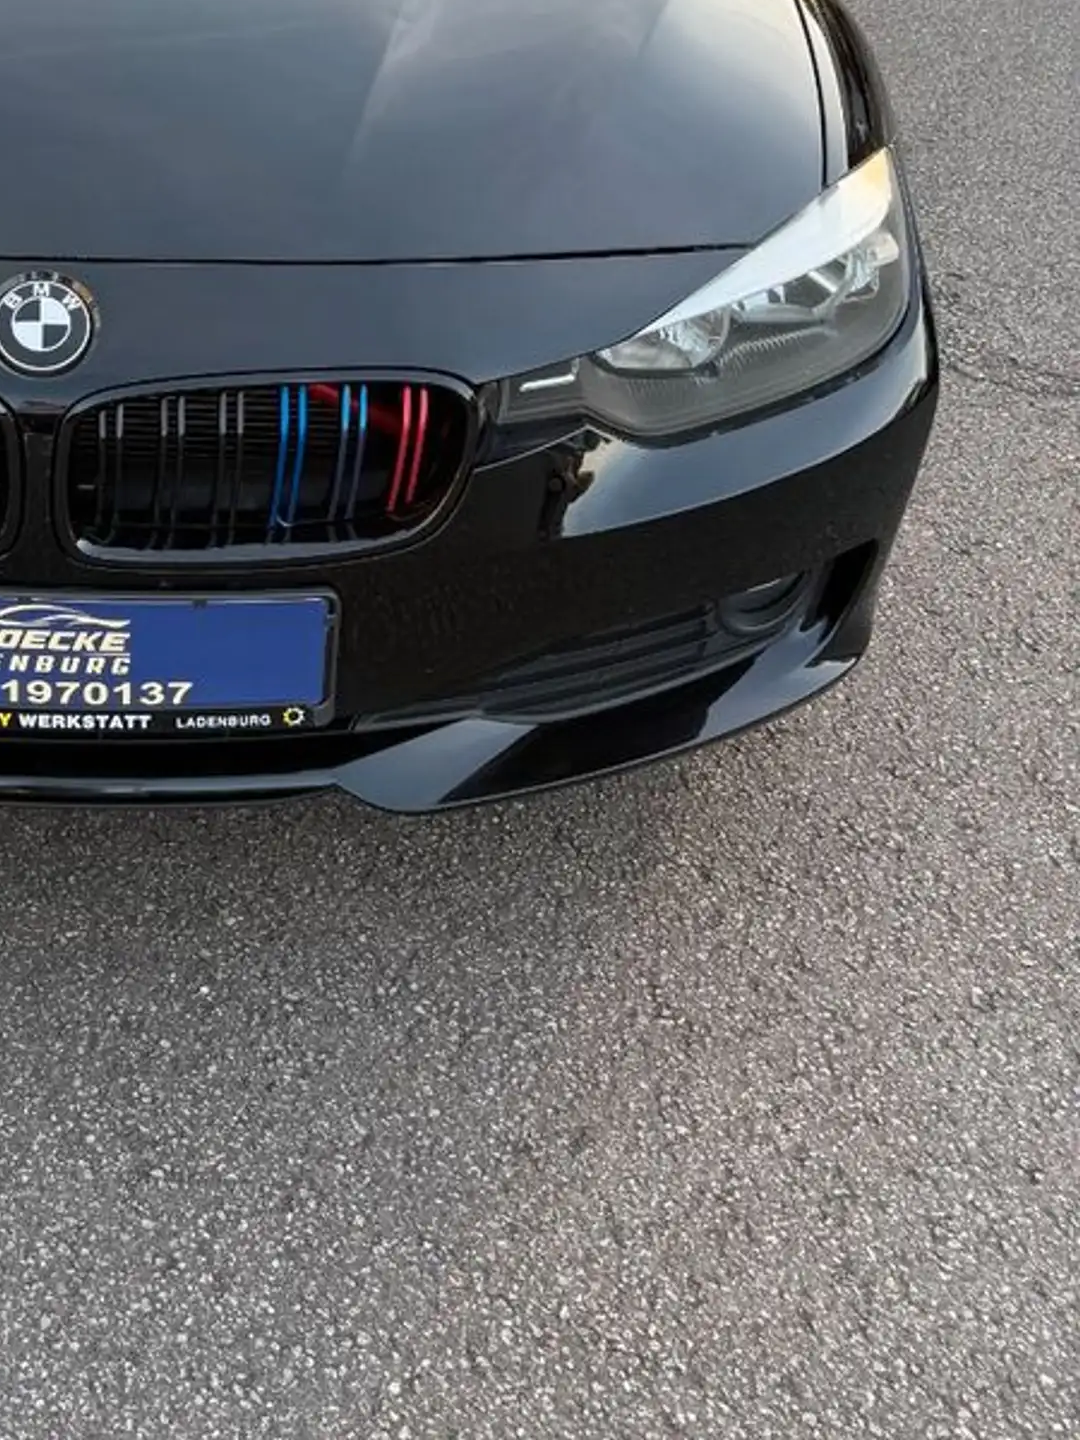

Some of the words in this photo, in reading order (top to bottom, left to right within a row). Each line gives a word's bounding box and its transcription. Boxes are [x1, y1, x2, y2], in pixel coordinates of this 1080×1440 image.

[3, 280, 82, 311] BMW
[1, 679, 193, 706] 1970137
[19, 713, 152, 729] WERKSTATT
[176, 714, 271, 729] LADENBURG
